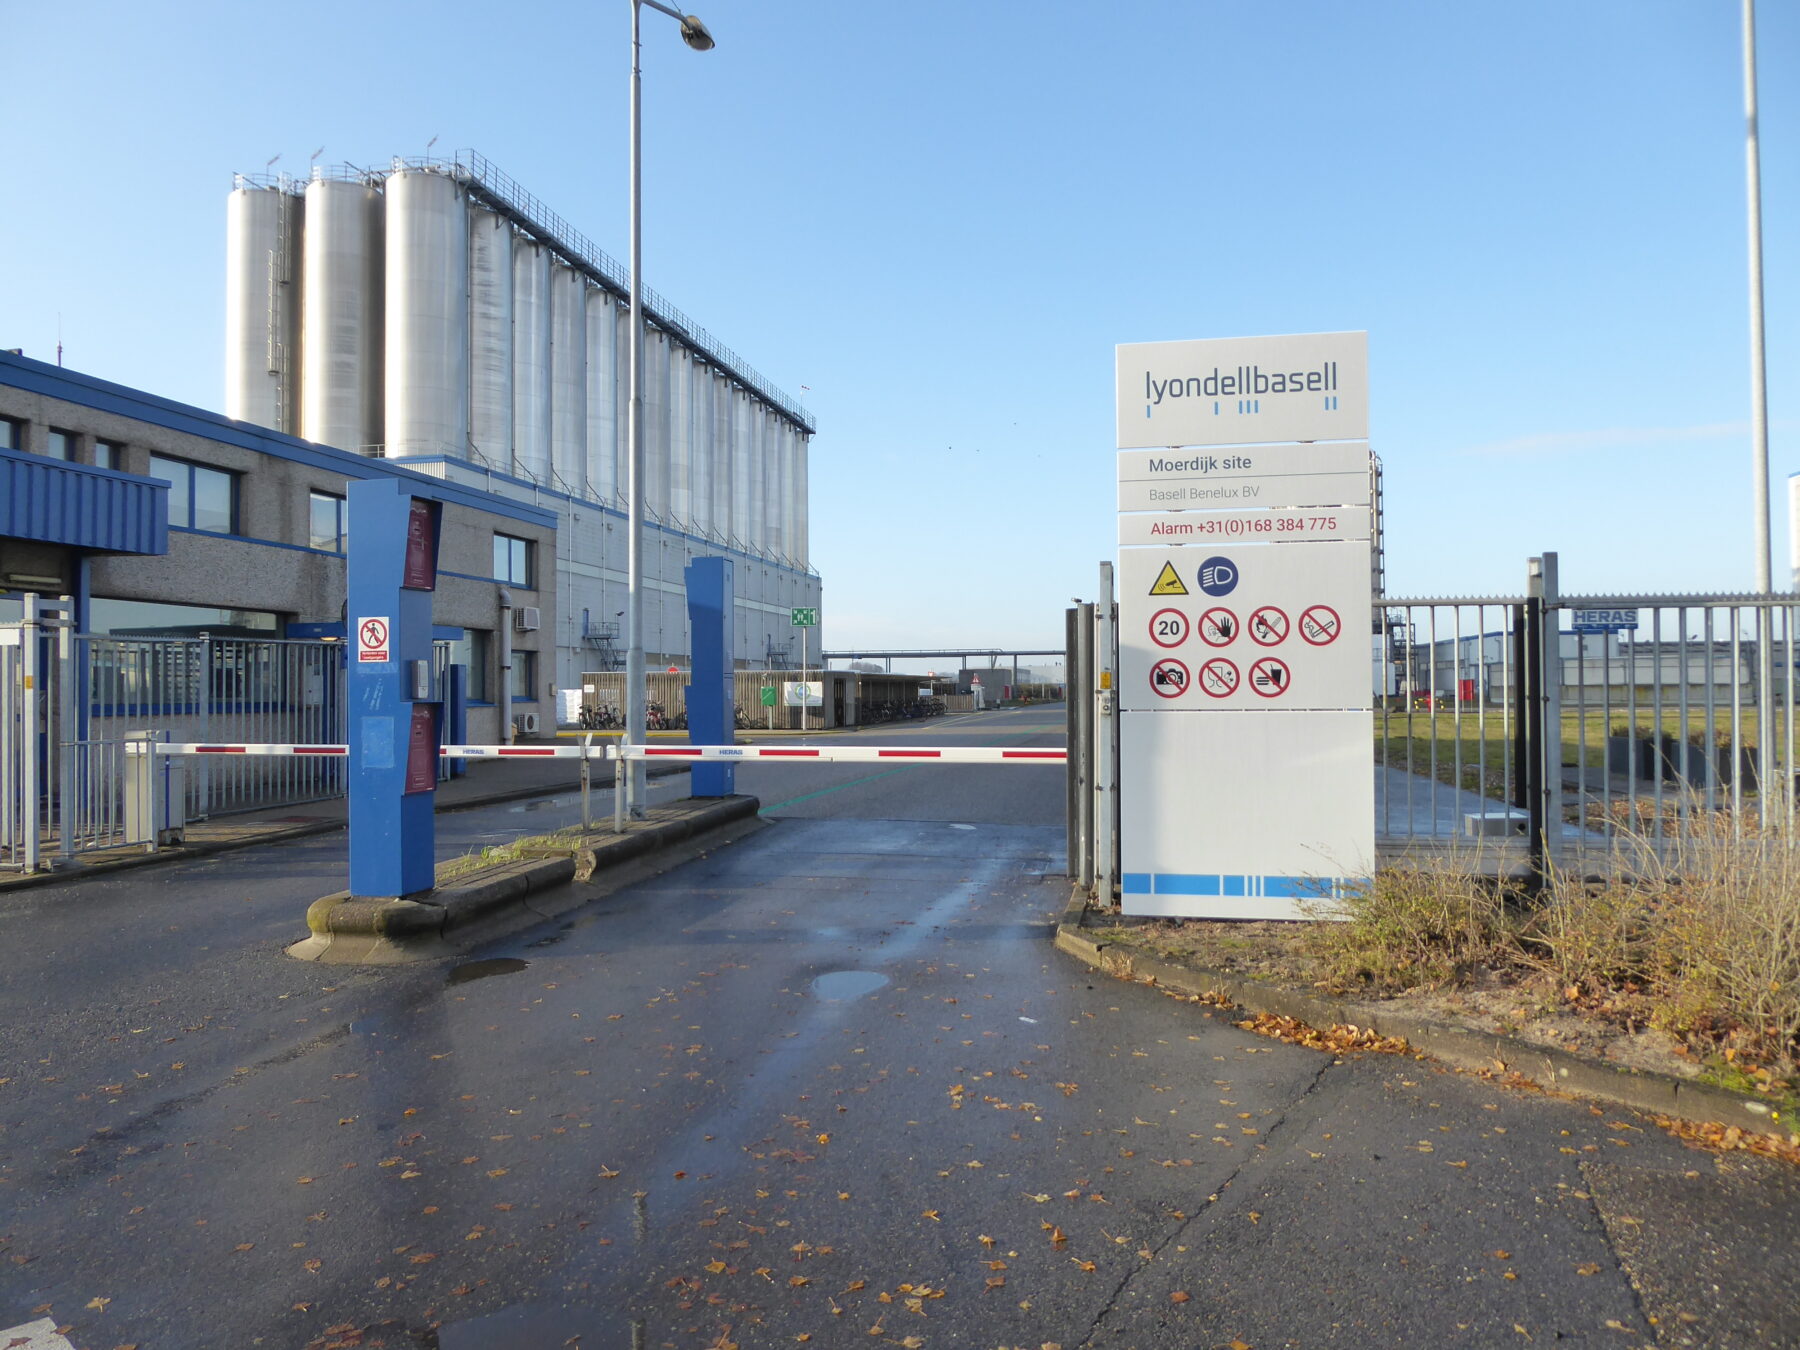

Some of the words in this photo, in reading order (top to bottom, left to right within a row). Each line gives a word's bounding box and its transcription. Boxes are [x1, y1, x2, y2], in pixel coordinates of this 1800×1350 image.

[1145, 361, 1337, 405] lyondellbasell
[1149, 456, 1218, 474] Moerdijk
[1222, 456, 1252, 470] site
[1149, 489, 1186, 501] Basell
[1189, 486, 1239, 500] Benelux
[1242, 485, 1260, 498] BV
[1150, 522, 1193, 536] Alarm
[1197, 519, 1272, 536] +31(0)168
[1276, 518, 1304, 532] 384
[1308, 517, 1337, 531] 775
[1574, 610, 1637, 622] HERAS
[1158, 620, 1180, 636] 20
